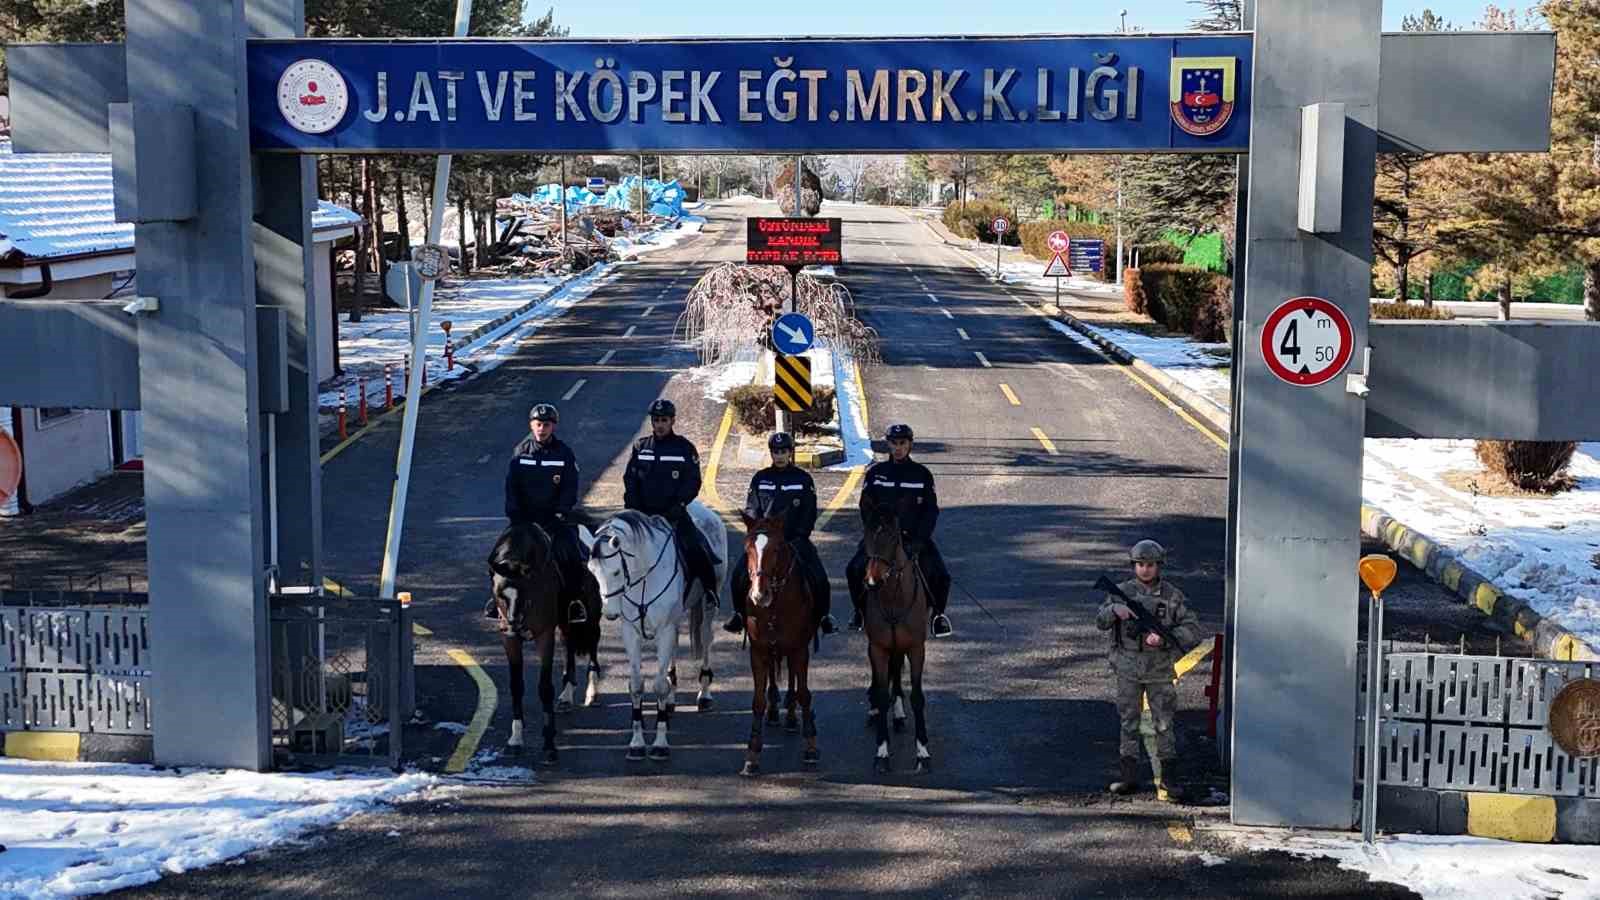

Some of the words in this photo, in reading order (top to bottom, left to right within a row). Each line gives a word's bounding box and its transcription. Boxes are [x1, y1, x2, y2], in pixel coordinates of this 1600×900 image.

[477, 71, 537, 121] VE
[556, 58, 722, 122] KÖPEK
[1280, 318, 1301, 364] 4
[1317, 318, 1331, 328] m
[1315, 346, 1334, 362] 50
